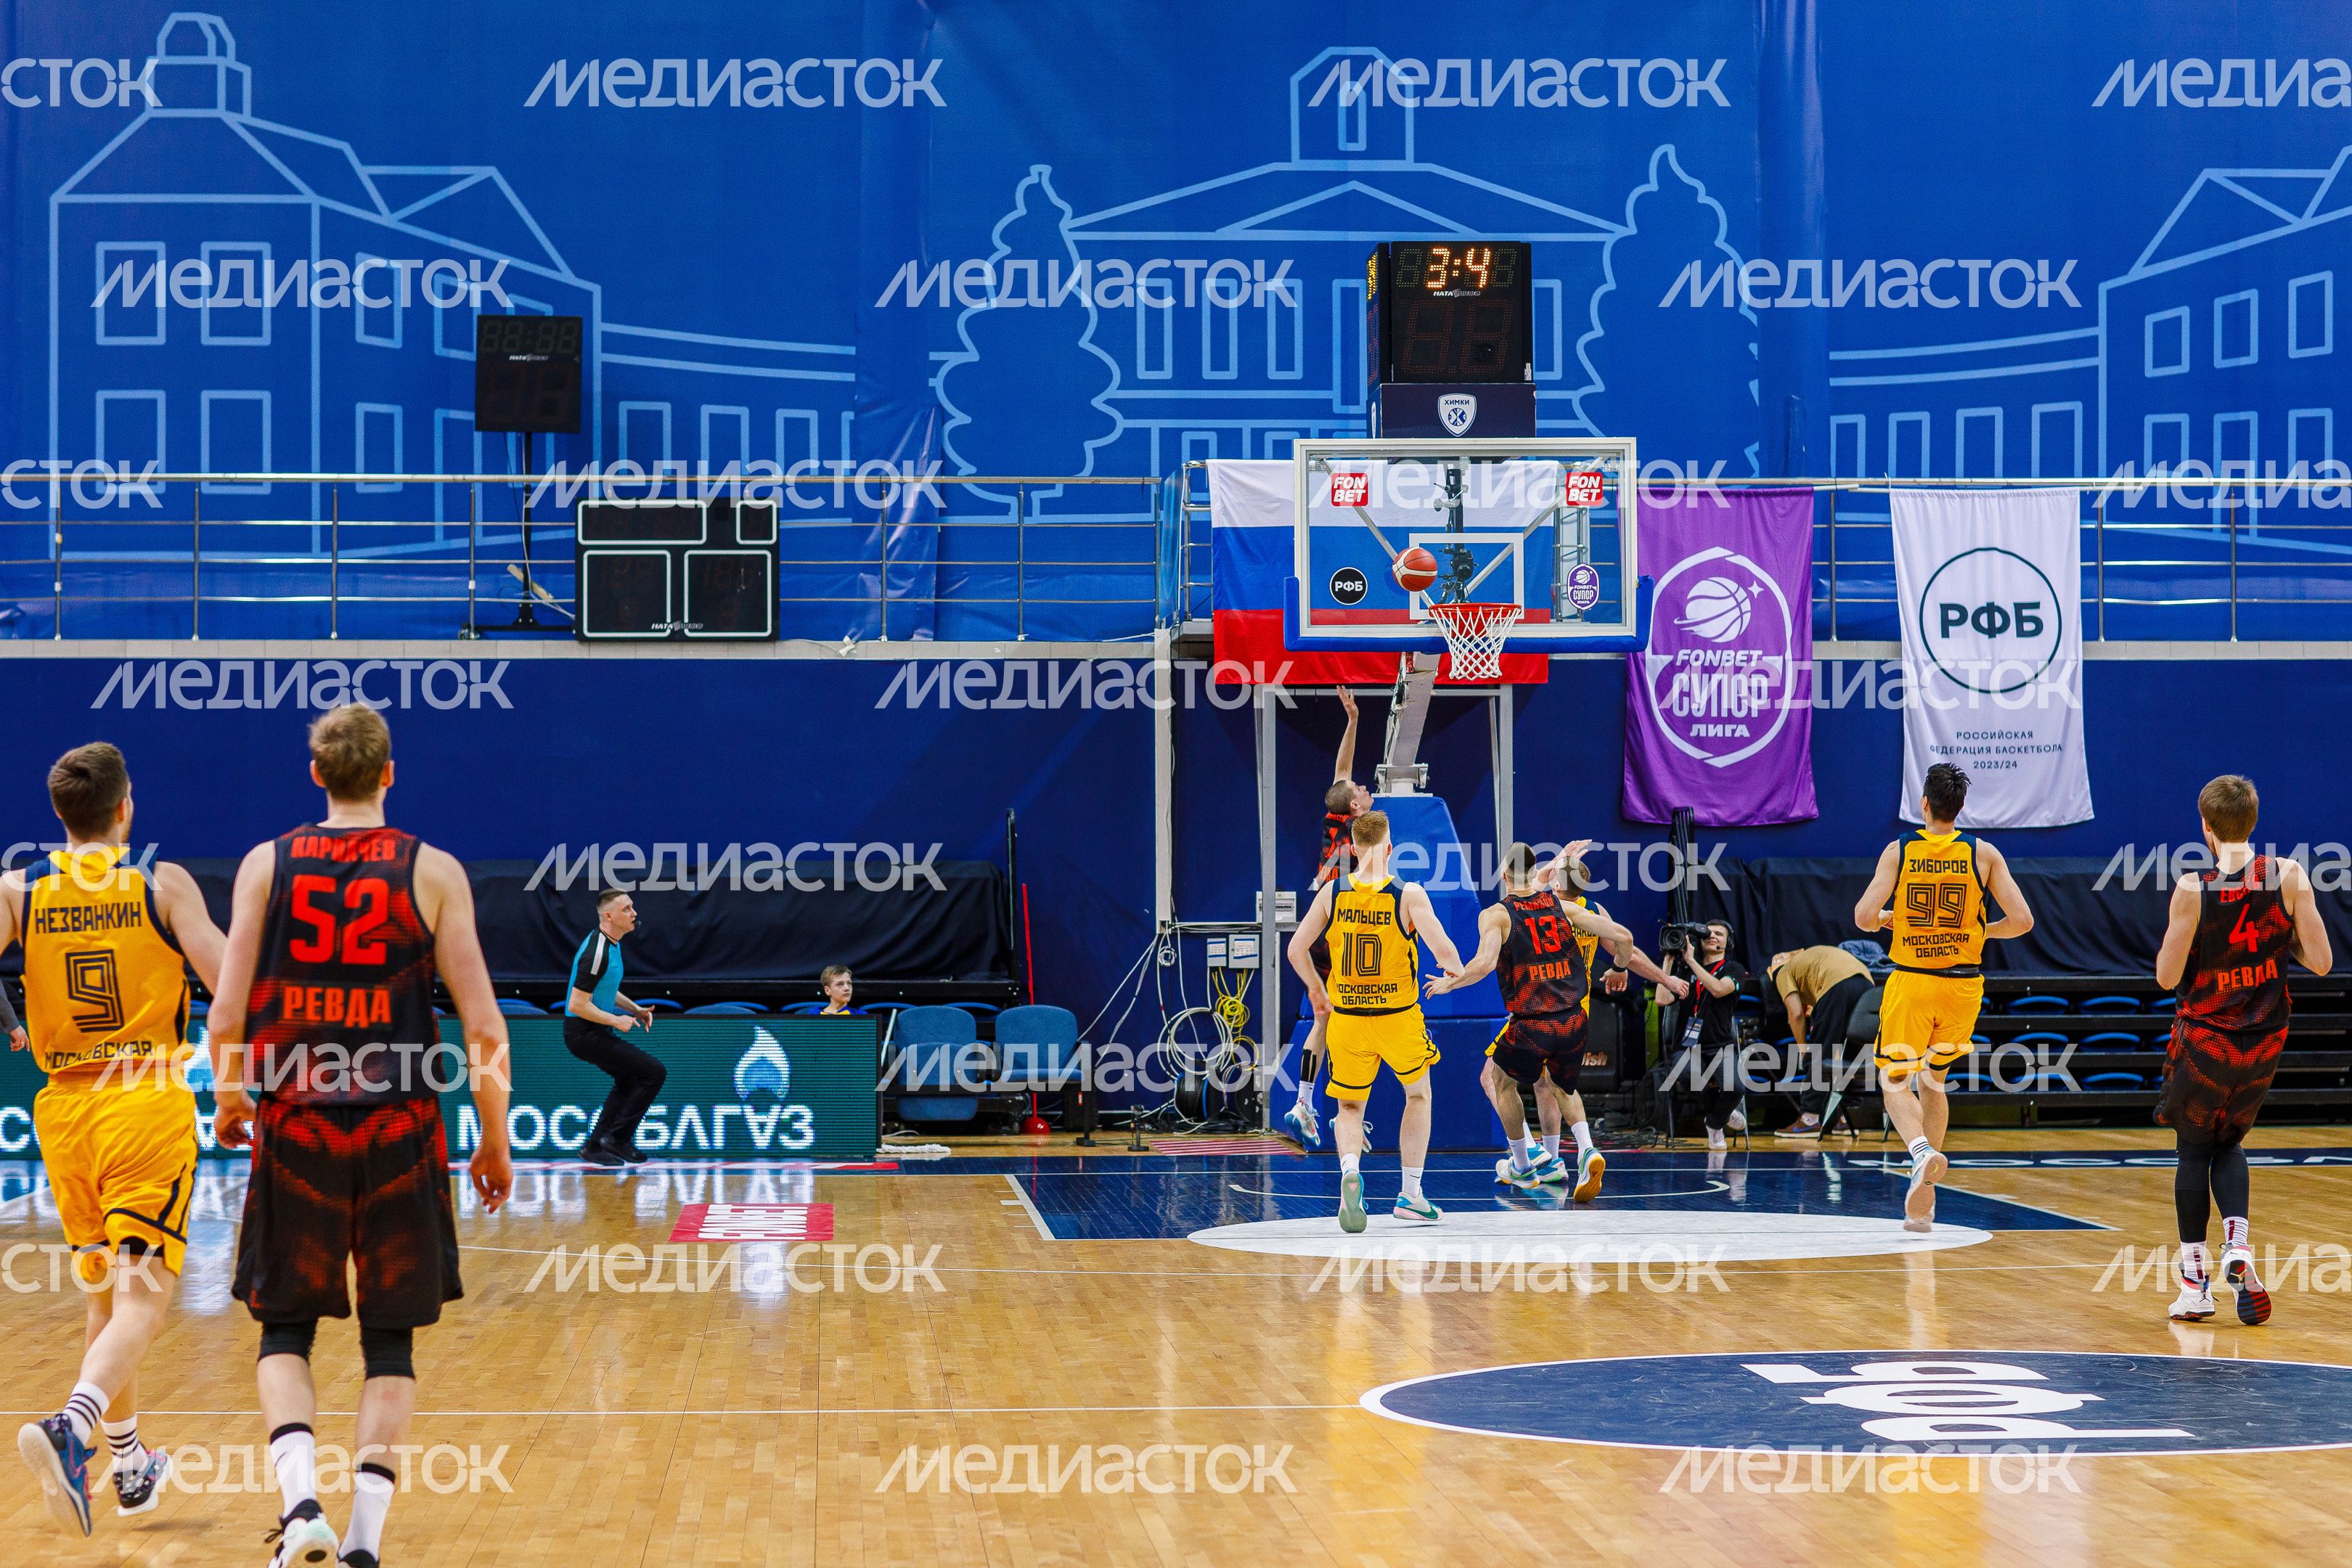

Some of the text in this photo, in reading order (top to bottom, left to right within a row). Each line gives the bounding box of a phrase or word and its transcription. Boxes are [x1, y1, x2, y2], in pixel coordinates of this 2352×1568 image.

[1334, 476, 1366, 489] FON
[1568, 475, 1601, 488] FON
[1334, 489, 1366, 503] BET
[1568, 489, 1601, 502] BET
[1334, 581, 1363, 592] РФБ
[1940, 601, 2043, 639] РФБ
[1676, 649, 1763, 667] FONBET
[1690, 724, 1750, 738] ЛИГА
[1956, 729, 2033, 740] РОССИЙСКАЯ
[1930, 743, 2063, 756] ФЕДЕРАЦИЯ БАСКЕТБОЛА
[1973, 760, 2018, 769] 2023/24
[1909, 859, 1968, 874] ЗИБОРОВ
[1906, 883, 1967, 929] 99
[35, 901, 142, 934] НЕЗВАНКИН
[289, 874, 390, 965] 52
[1337, 908, 1392, 926] МАЛЬЦЕВ
[1524, 915, 1561, 955] 13
[2229, 903, 2260, 952] 4
[1902, 933, 1969, 946] МОСКОВСКАЯ
[1342, 932, 1382, 977] 10
[1916, 945, 1959, 957] ОБЛАСТЬ
[1529, 960, 1572, 981] РЕВДА
[2217, 959, 2279, 992] РЕВДА
[65, 949, 124, 1033] 9
[1336, 983, 1398, 995] ОСКОВСКАЯ
[282, 986, 392, 1029] РЕВДА
[1342, 995, 1387, 1005] ОБЛАСТЬ
[456, 1104, 815, 1151] МОСБЛГАЗ
